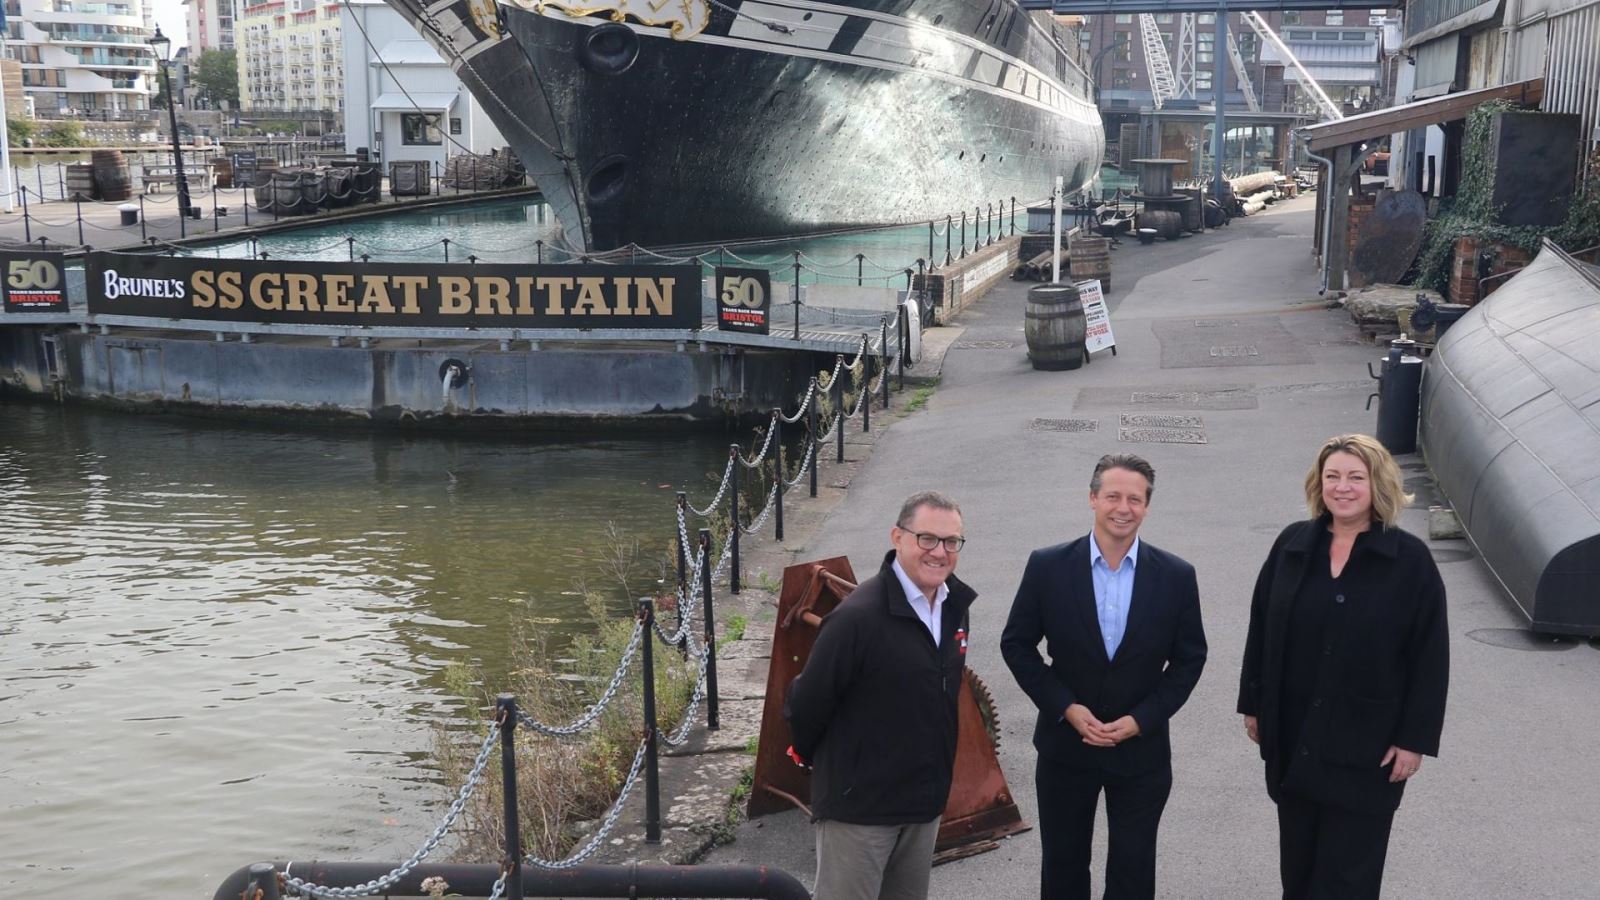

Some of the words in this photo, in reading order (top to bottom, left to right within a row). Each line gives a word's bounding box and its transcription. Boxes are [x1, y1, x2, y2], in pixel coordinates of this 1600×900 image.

[8, 259, 59, 289] 50
[9, 294, 62, 303] BRISTOL
[103, 269, 186, 300] BRUNEL'S
[191, 270, 243, 309] SS
[250, 273, 428, 314] GREAT
[438, 276, 675, 316] BRITAIN
[722, 275, 765, 308] 50
[722, 312, 765, 324] BRISTOL
